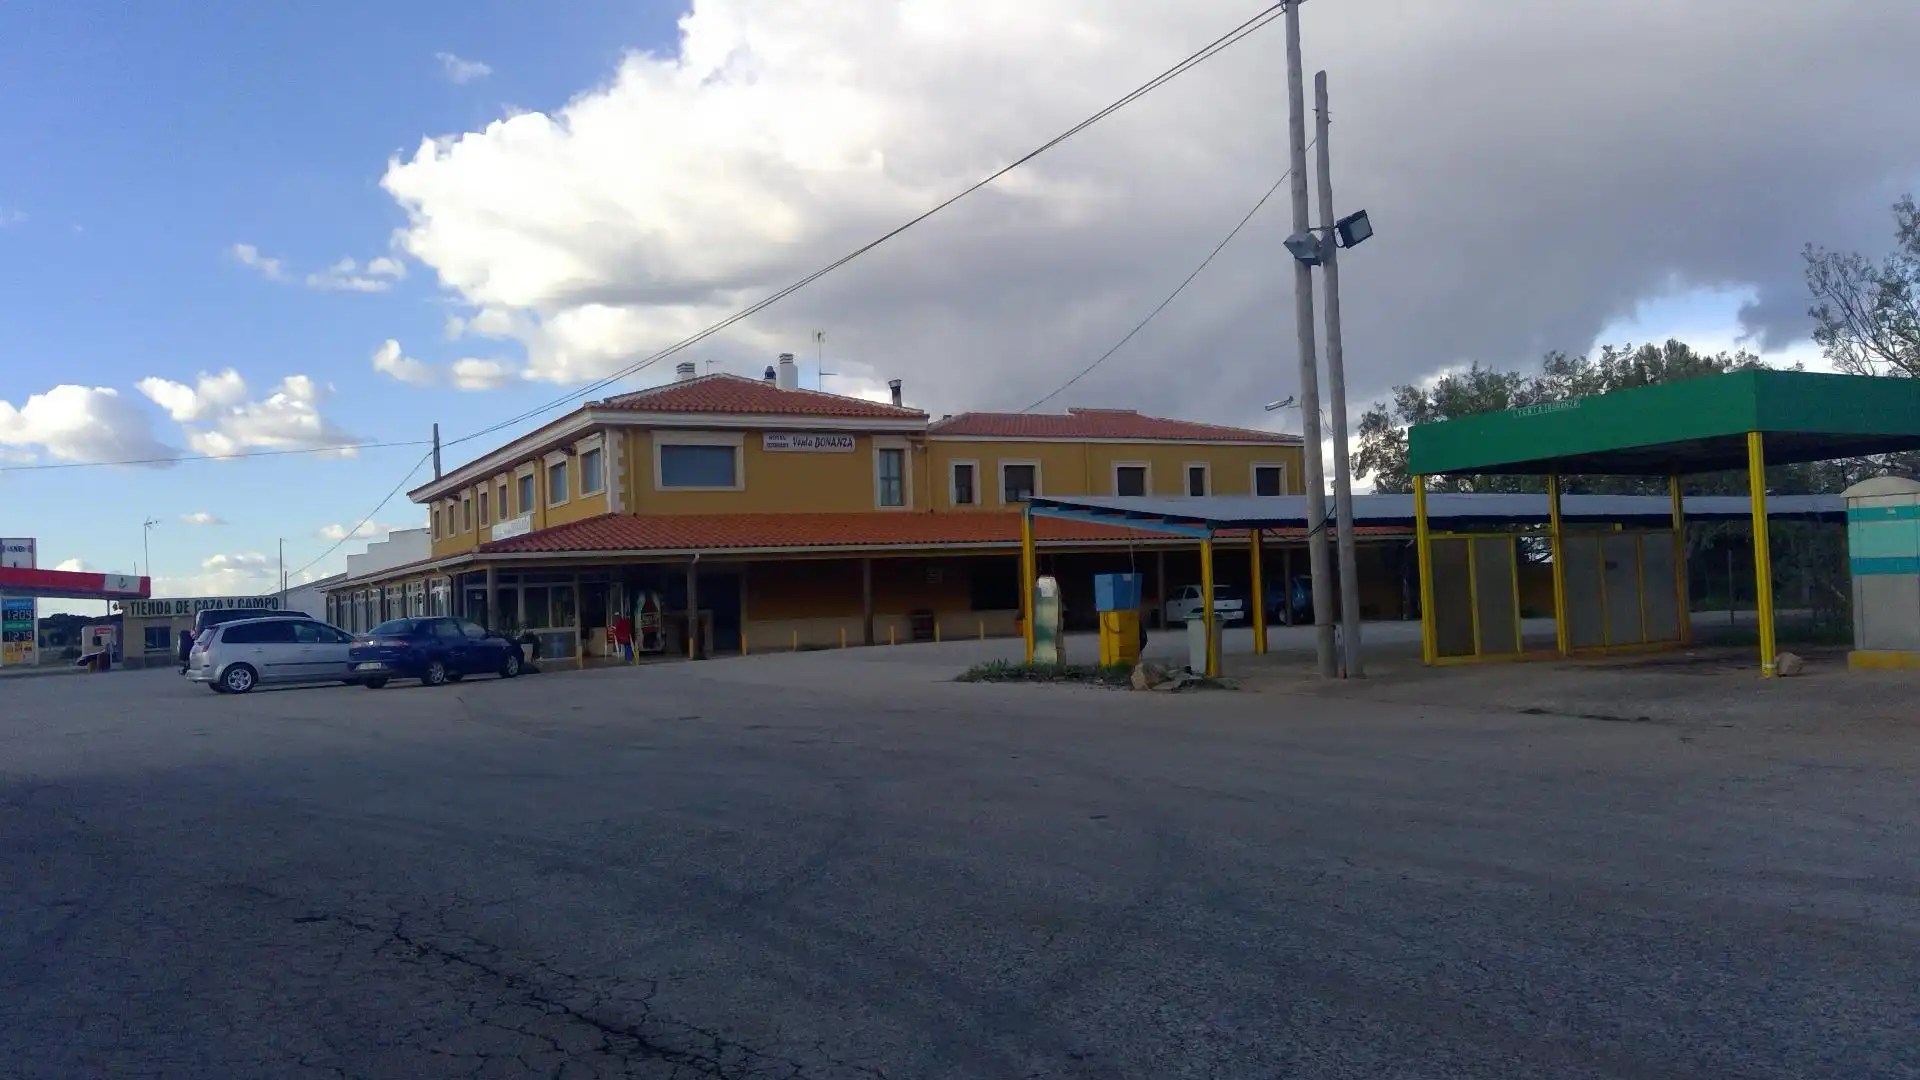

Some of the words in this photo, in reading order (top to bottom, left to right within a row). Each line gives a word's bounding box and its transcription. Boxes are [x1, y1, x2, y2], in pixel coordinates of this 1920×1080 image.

[814, 435, 853, 448] BONANZA
[130, 599, 171, 616] TIENDA
[175, 598, 190, 614] DE
[194, 597, 223, 611] CAZA
[237, 596, 279, 610] CAMPO
